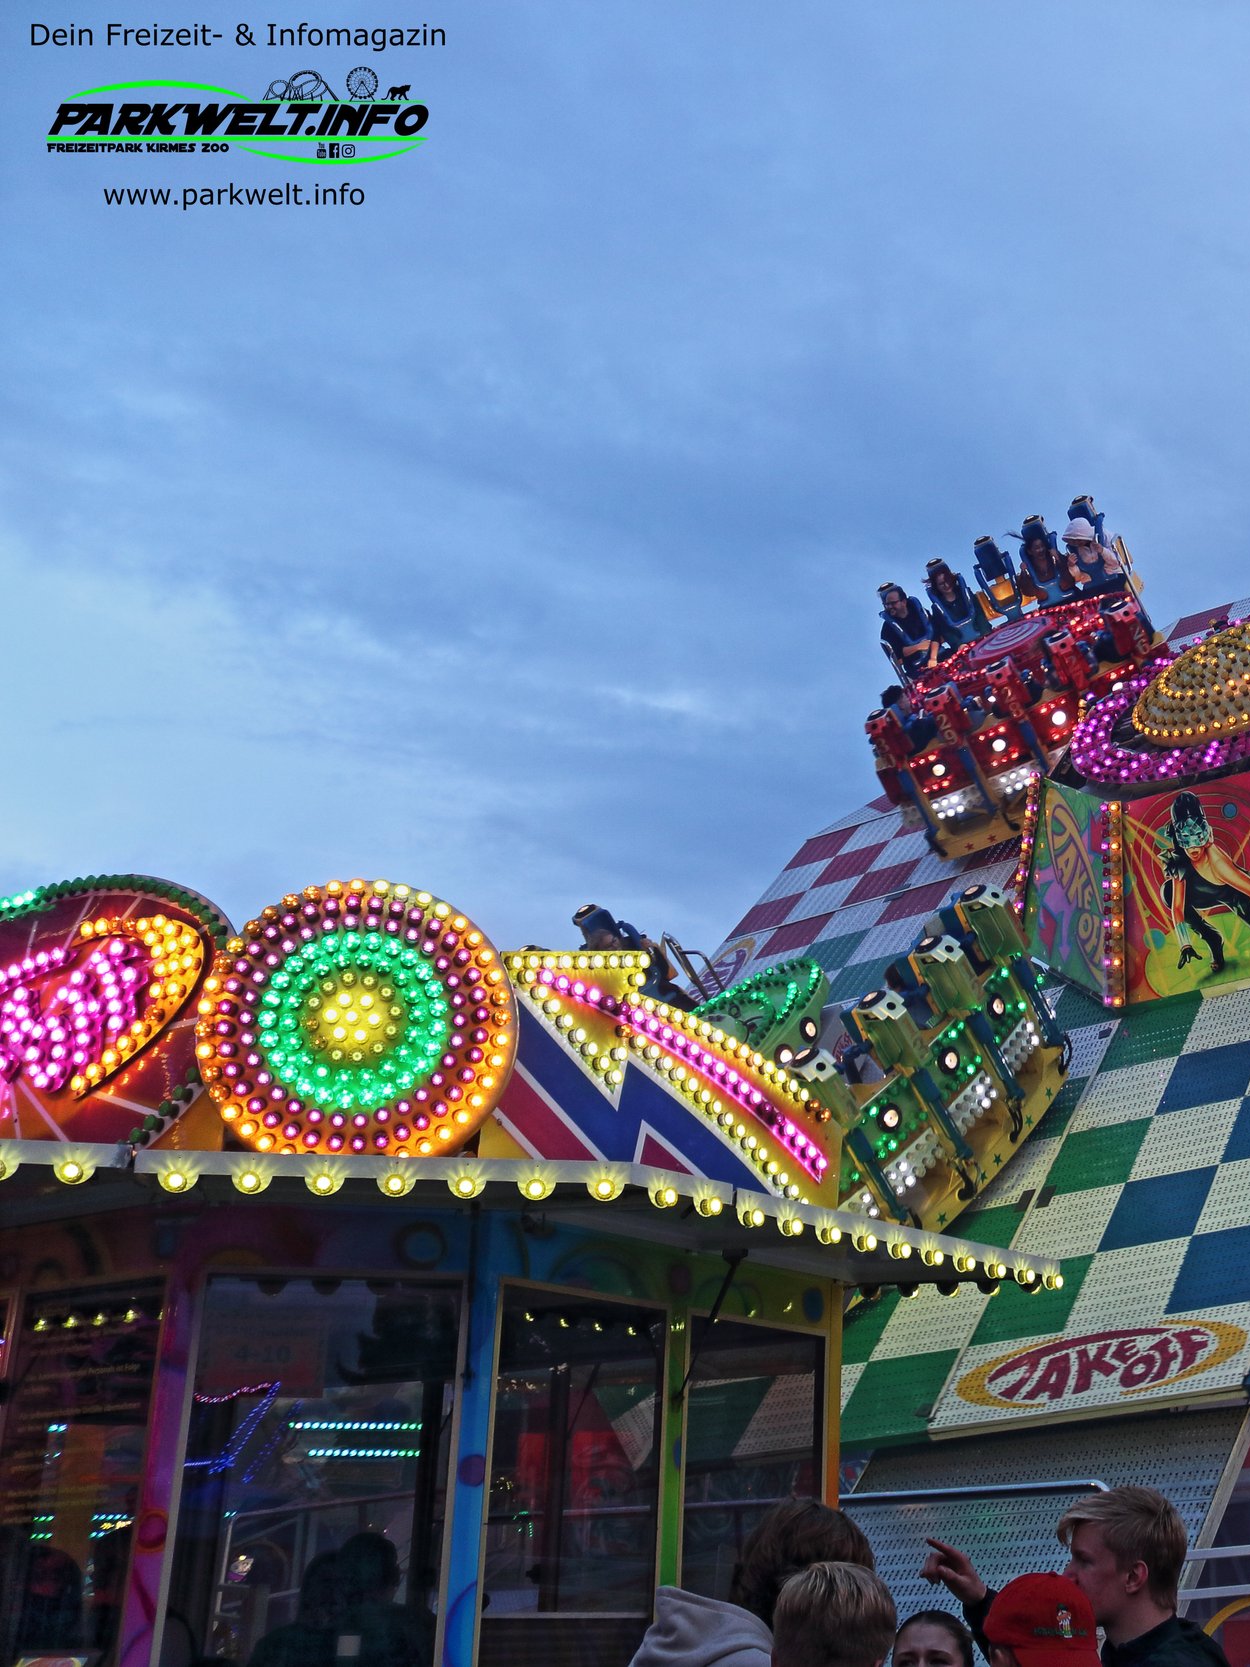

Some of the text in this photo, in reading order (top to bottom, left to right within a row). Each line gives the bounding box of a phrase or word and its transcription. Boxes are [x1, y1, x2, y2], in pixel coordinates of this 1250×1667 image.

[936, 713, 957, 745] 29
[988, 1327, 1209, 1400] TAKE OFF
